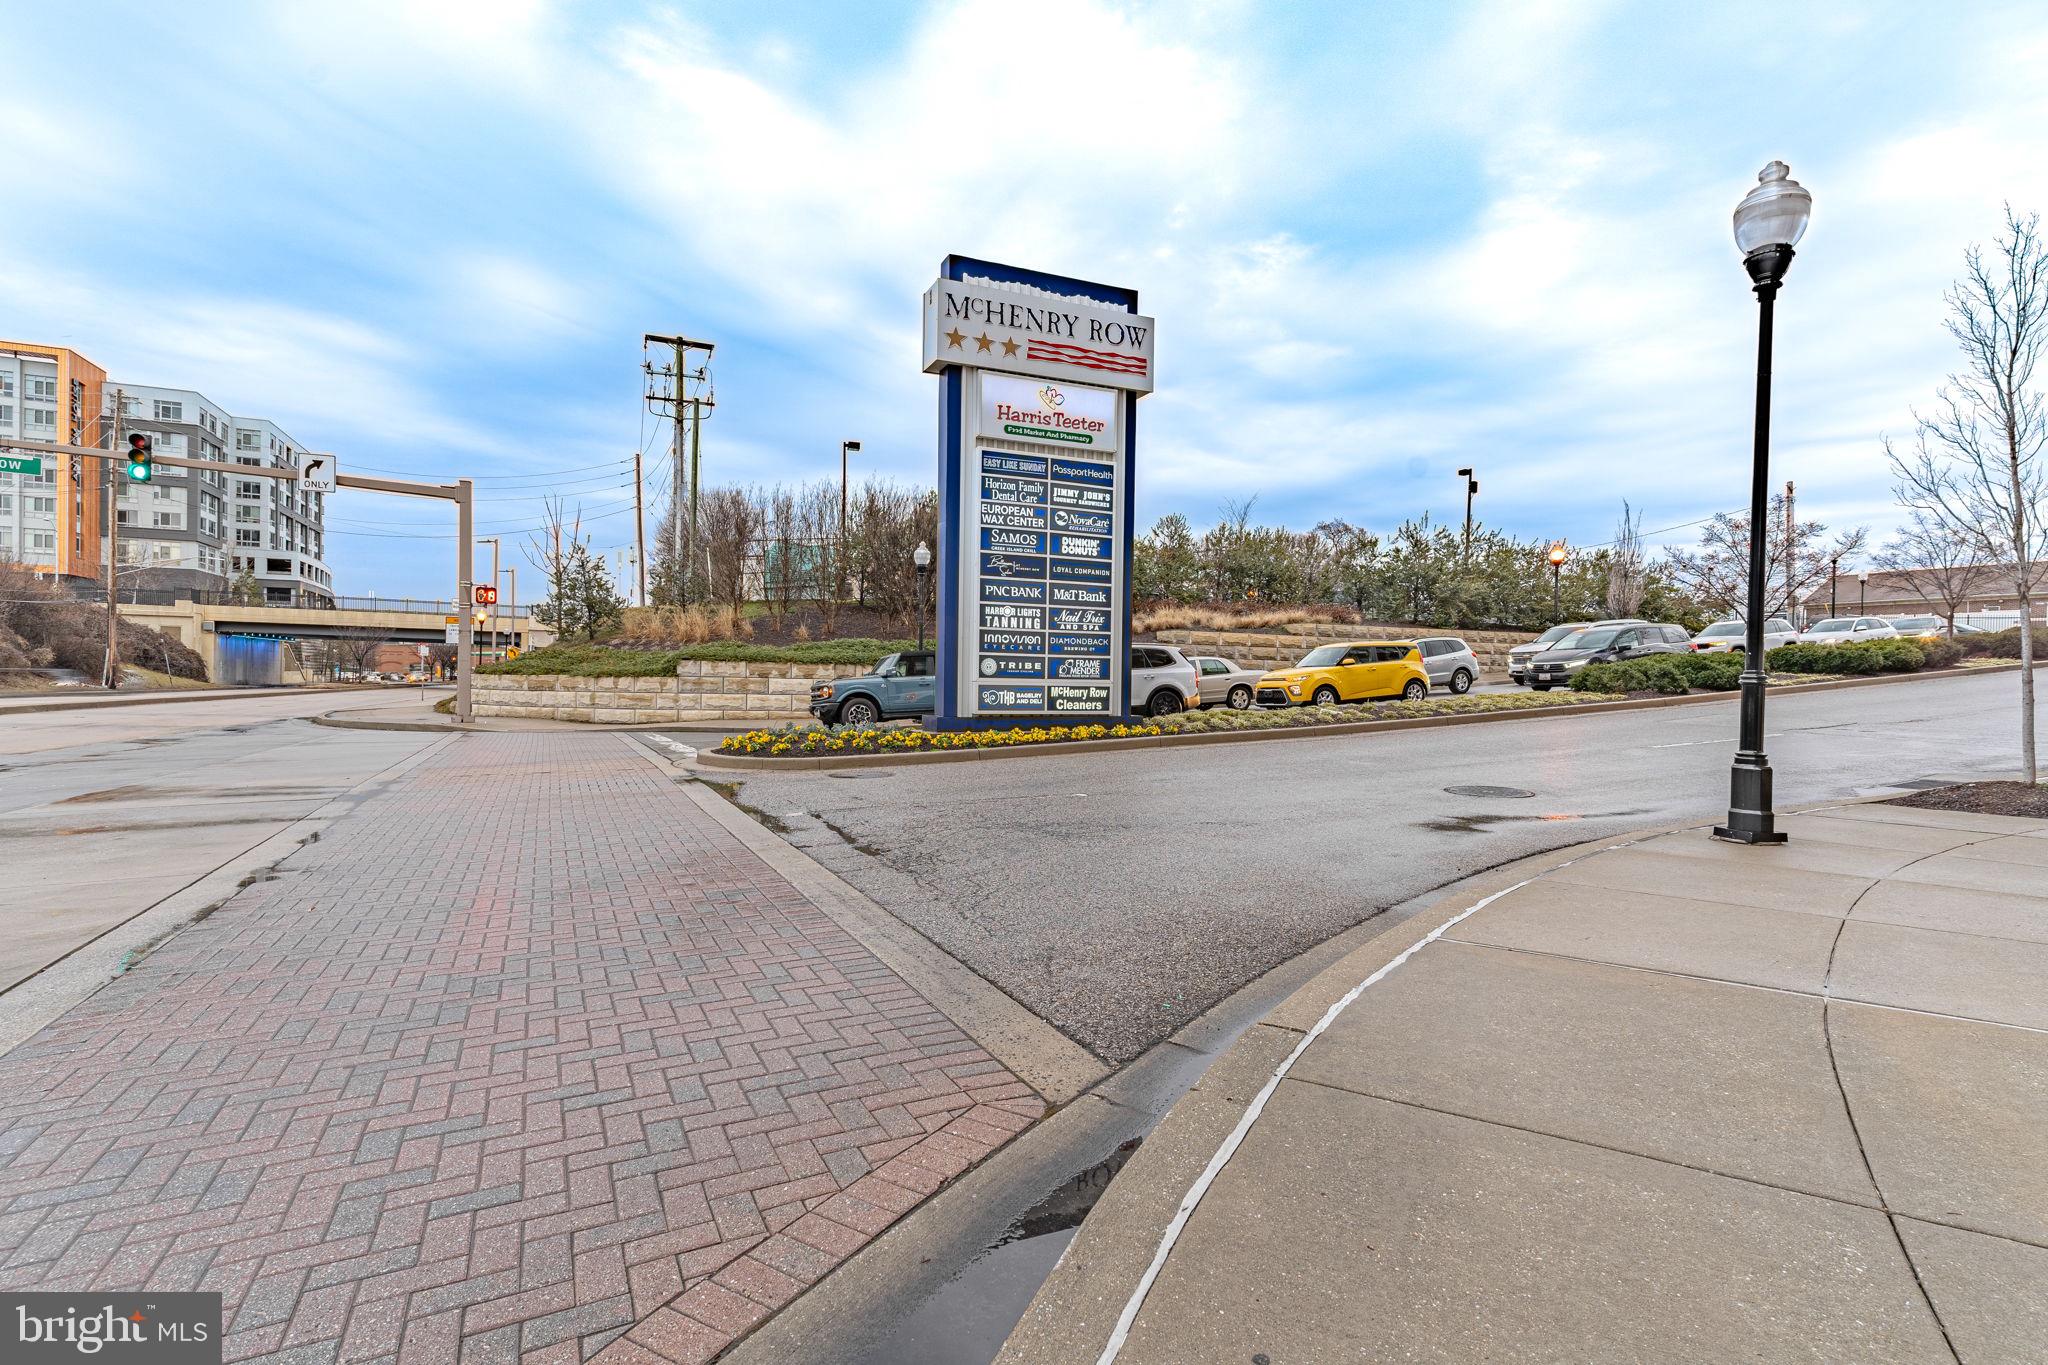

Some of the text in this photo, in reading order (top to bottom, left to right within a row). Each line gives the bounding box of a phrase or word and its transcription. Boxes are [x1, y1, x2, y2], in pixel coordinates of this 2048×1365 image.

[1090, 319, 1147, 350] ROW
[1060, 434, 1089, 442] Pharmacy
[71, 428, 80, 481] ANTEM
[984, 458, 1046, 472] EASY LIKE SUNDAY
[985, 478, 1044, 495] Horizon Family
[992, 490, 1037, 503] Dental Care
[1053, 488, 1110, 501] JIMMY JOHN'S
[982, 504, 1033, 516] EUROPEAN
[982, 514, 1044, 527] WAX CENTER
[1068, 514, 1109, 528] NovaCare
[991, 529, 1037, 545] SAMOS
[1062, 536, 1099, 548] DUNKIN'
[1062, 545, 1097, 556] DONUTS
[985, 586, 1041, 598] PNC BANK
[1054, 589, 1106, 602] M&T Bank
[986, 606, 1040, 617] HARBOR LIGHTS
[1054, 609, 1105, 623] Nail Trix
[986, 616, 1040, 629] TANNING
[1090, 689, 1107, 697] Row
[1056, 700, 1102, 710] Cleaners
